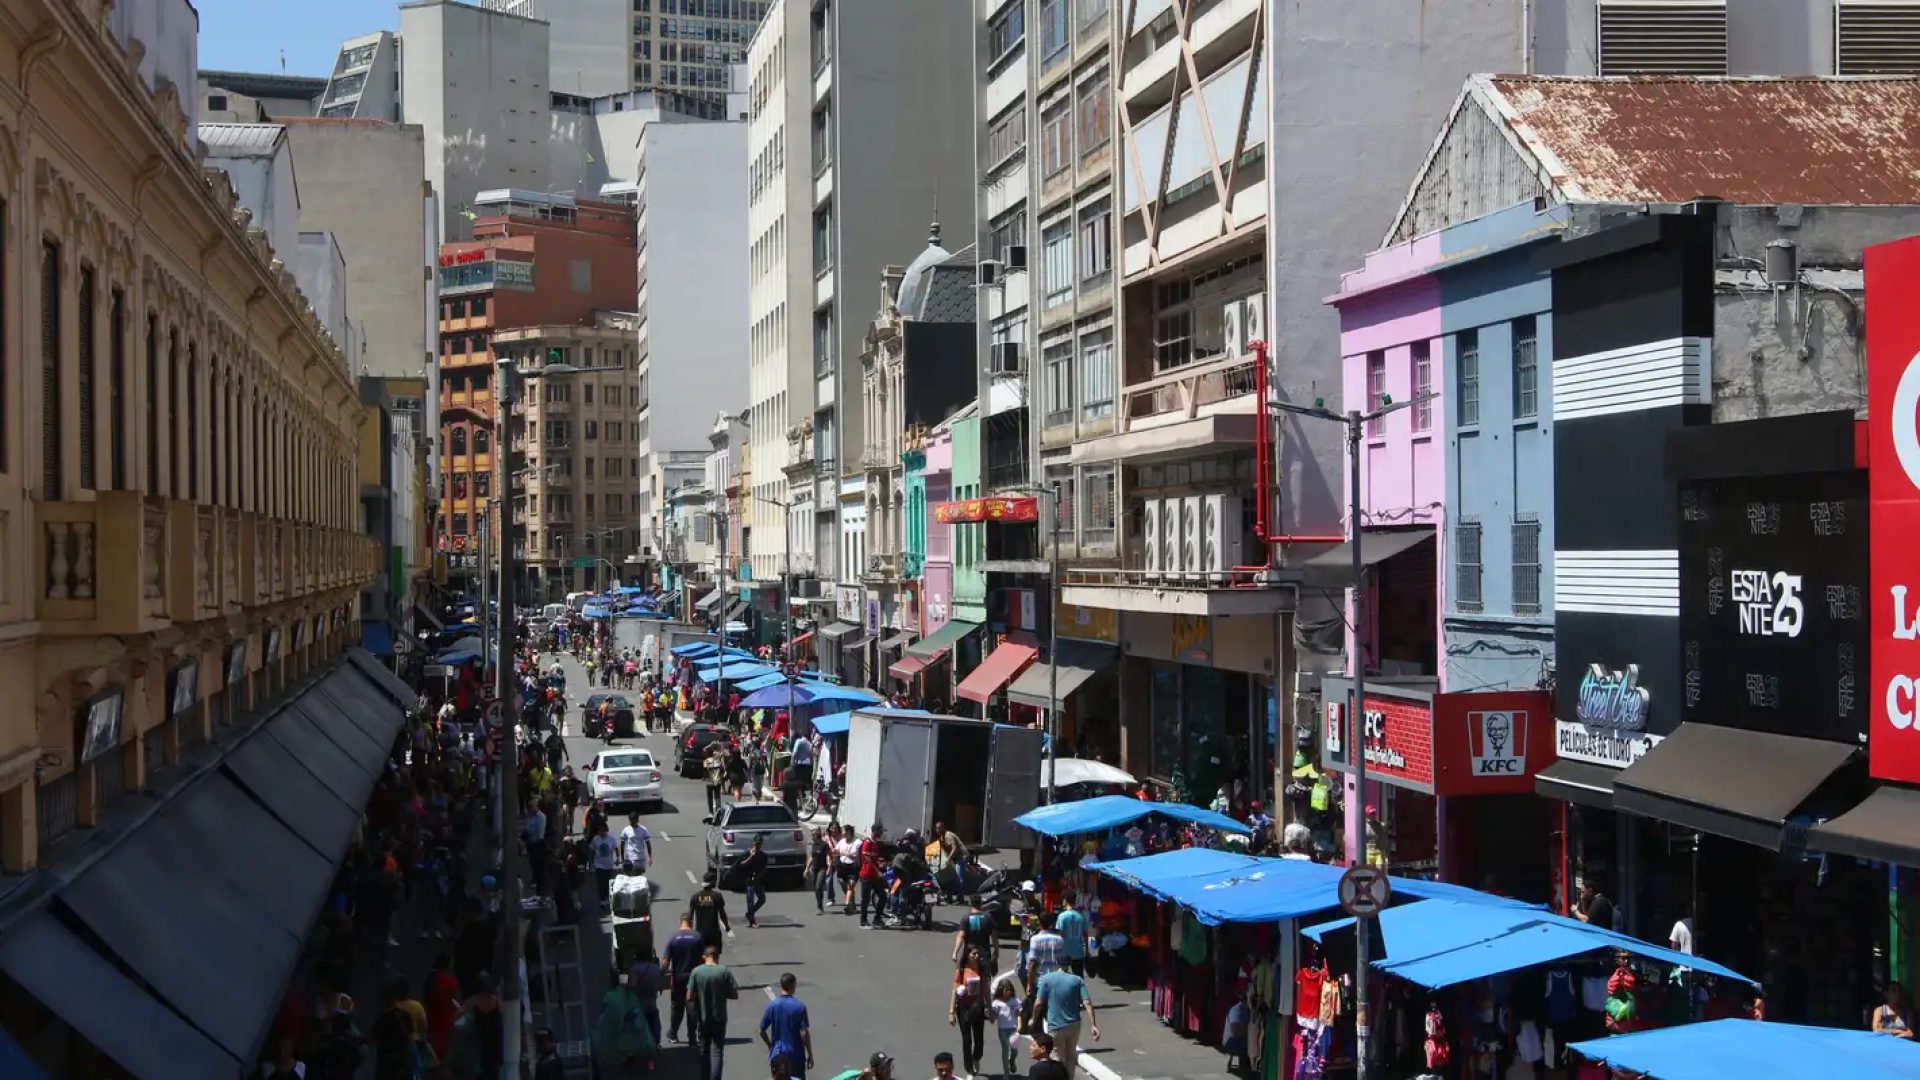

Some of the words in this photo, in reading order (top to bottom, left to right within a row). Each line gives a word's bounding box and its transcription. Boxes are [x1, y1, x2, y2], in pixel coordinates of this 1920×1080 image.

[1732, 570, 1773, 603] ESTA
[1739, 603, 1773, 636] NTE
[1772, 571, 1804, 638] 25
[1363, 711, 1383, 738] FC
[1480, 759, 1517, 773] KFC
